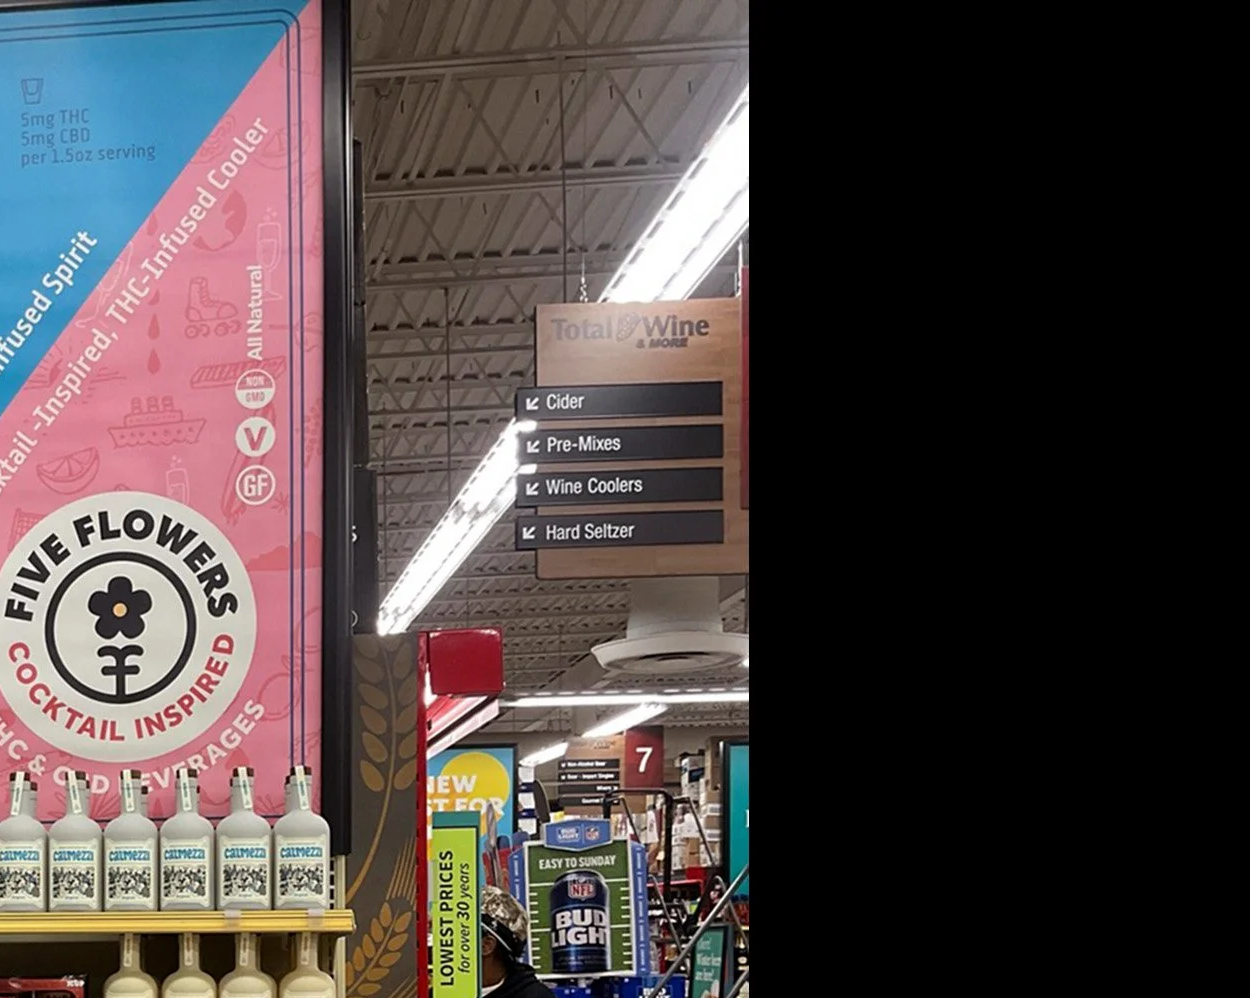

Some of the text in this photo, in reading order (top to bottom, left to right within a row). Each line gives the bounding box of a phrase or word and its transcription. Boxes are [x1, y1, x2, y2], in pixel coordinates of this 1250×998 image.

[21, 108, 90, 131] 5mg THC
[21, 128, 90, 149] 5mg CBD
[21, 144, 157, 169] per 1.5oz serving
[105, 186, 216, 328] THC-Infused
[207, 116, 270, 191] Cooler
[42, 229, 98, 296] Spirit
[247, 264, 263, 361] All Natural
[551, 314, 710, 341] Total Wine
[649, 337, 689, 349] MORE
[546, 393, 585, 410] Cider
[546, 435, 621, 453] Pre-Mixes
[242, 474, 268, 497] GF
[546, 477, 643, 495] Wine Coolers
[546, 523, 635, 541] Hard Seltzer
[3, 508, 239, 622] FIVE FLOWERS
[7, 633, 235, 742] COCKTAIL INSPIRED
[28, 754, 47, 776] &
[635, 746, 653, 773] 7
[539, 855, 616, 870] EASY TO SUNDAY
[439, 850, 454, 986] LOWEST PRICES
[457, 862, 473, 974] for over 30 years
[555, 908, 606, 929] BUD
[551, 926, 606, 948] LIGH
